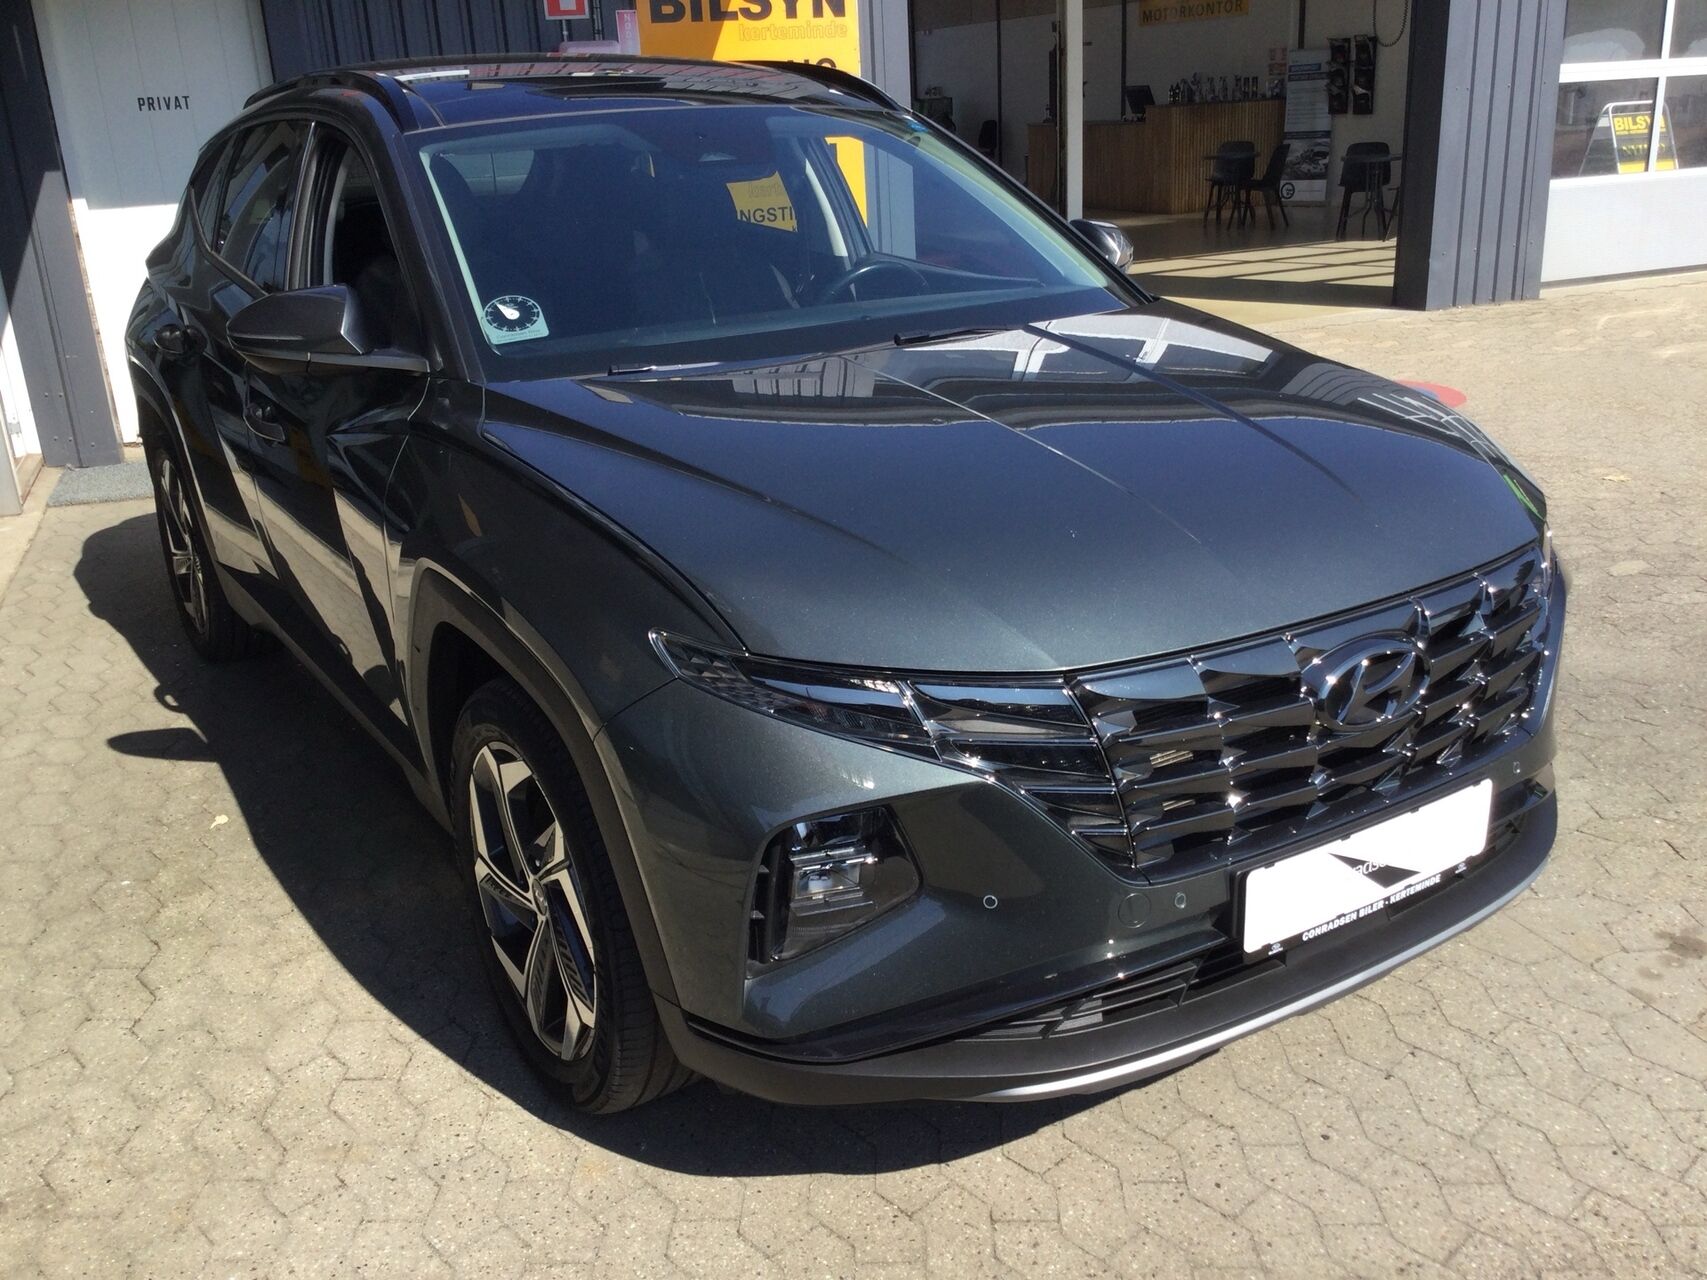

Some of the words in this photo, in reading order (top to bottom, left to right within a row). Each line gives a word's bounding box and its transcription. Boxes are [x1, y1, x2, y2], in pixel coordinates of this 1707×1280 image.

[649, 0, 846, 24] BILSYN
[1142, 0, 1244, 23] MOTORKONTOR
[738, 20, 848, 41] kerteminde
[137, 95, 190, 111] PRIVAT
[1302, 911, 1358, 942] CONRADSEN
[1358, 899, 1385, 918] BILER
[1389, 874, 1442, 904] KERTEMINDE
